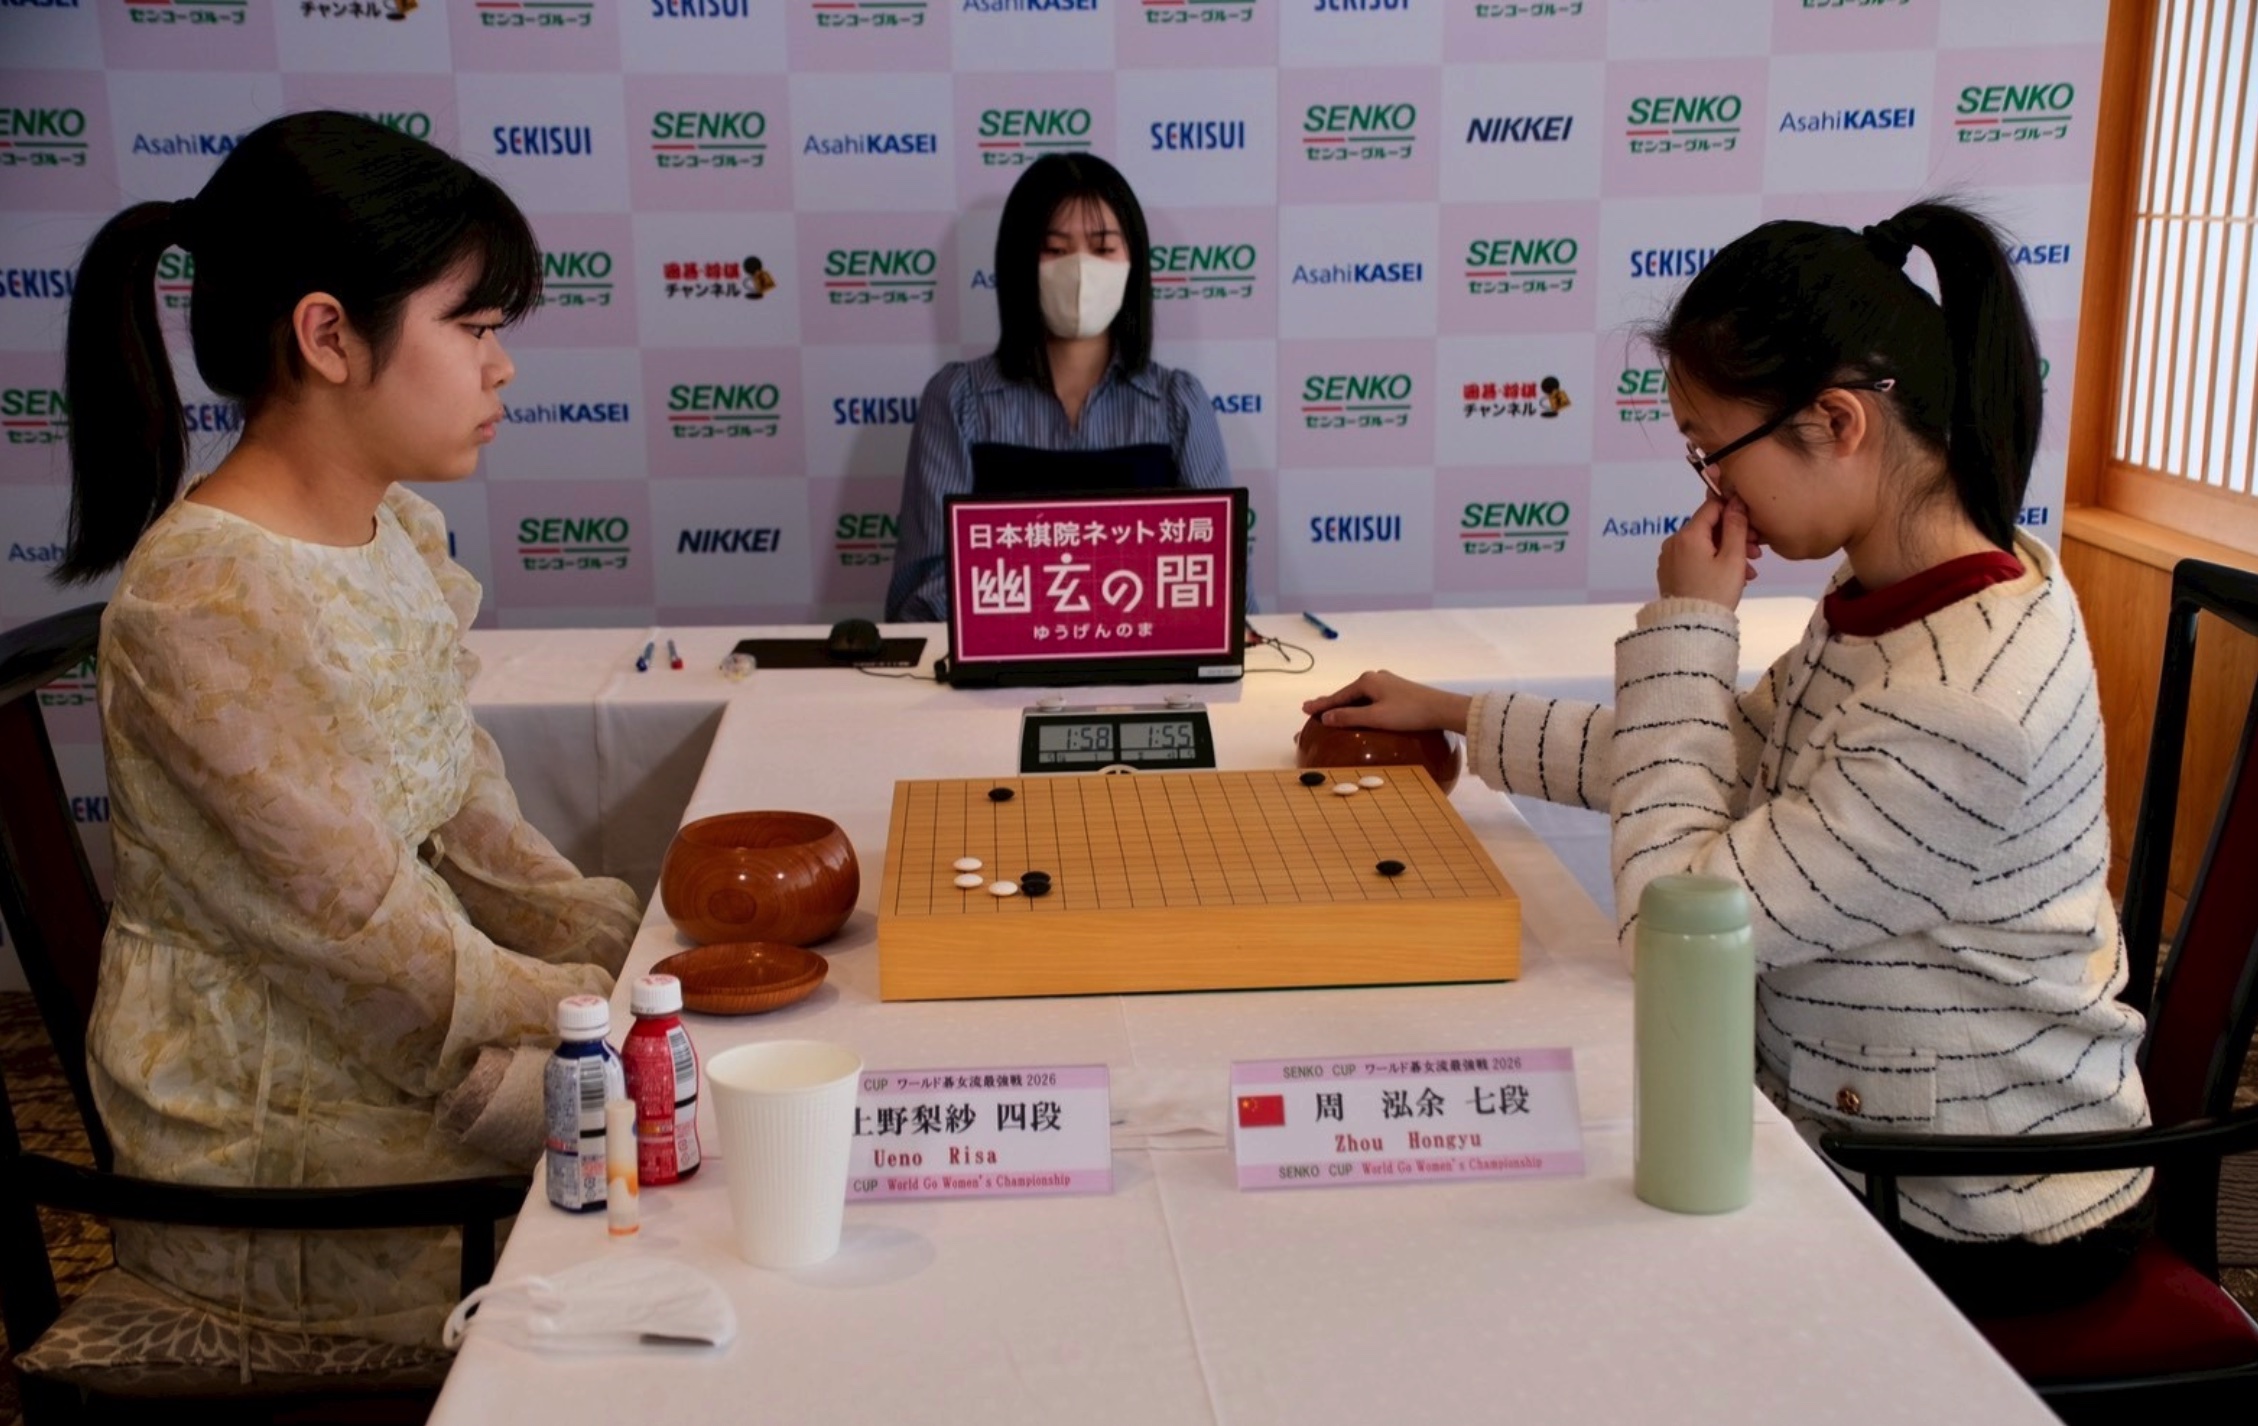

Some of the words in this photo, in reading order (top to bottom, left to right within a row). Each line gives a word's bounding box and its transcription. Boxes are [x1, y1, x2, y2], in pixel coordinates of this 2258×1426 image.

[1627, 95, 1741, 124] SENKO
[1956, 83, 2074, 114] SENKO
[0, 108, 85, 137] ENKO
[651, 111, 765, 139] SENKO
[978, 109, 1091, 137] SENKO
[1303, 104, 1416, 132] SENKO
[1466, 116, 1573, 143] NIKKEI
[1779, 109, 1915, 132] AsahiKASEI
[133, 133, 243, 155] AsahiKA
[493, 126, 592, 156] SEKISUI
[803, 134, 937, 155] AsahiKASEI
[1151, 121, 1245, 150] SEKISUI
[544, 252, 612, 278] NKO
[825, 249, 937, 276] SENKO
[1149, 245, 1256, 272] SENKO
[1466, 238, 1577, 266] SENKO
[1630, 249, 1714, 277] SEKISU
[1292, 263, 1423, 284] AsahiKASEI
[668, 384, 779, 411] SENKO
[1302, 374, 1411, 401] SENKO
[2, 389, 72, 416] SEN
[833, 397, 918, 425] SEKISU
[836, 514, 900, 539] SEN
[1461, 501, 1569, 529] SENKO
[1602, 516, 1691, 537] AsahiK
[518, 517, 629, 544] SENKO
[677, 529, 780, 553] NIKKEI
[969, 517, 1214, 549] 日本棋院ネット対局
[1311, 515, 1401, 543] SEKISUI
[971, 552, 1214, 615] 幽玄の間
[1033, 622, 1154, 641] ゆうげんのま
[1067, 727, 1109, 751] 1:58
[1149, 725, 1190, 749] 1:55
[1283, 1066, 1323, 1078] SENKO
[1332, 1064, 1356, 1076] CUP
[1493, 1057, 1522, 1071] 2026
[864, 1078, 888, 1091] CUP
[1027, 1073, 1056, 1086] 2026
[1465, 1085, 1529, 1115] 七段
[852, 1103, 977, 1136] 上野梨紗
[997, 1101, 1061, 1132] 四段
[1335, 1134, 1383, 1153] Zhou
[1408, 1131, 1481, 1150] Hongyu
[874, 1149, 922, 1168] Ueno
[949, 1145, 997, 1165] Risa
[1279, 1165, 1319, 1179] SENKO
[1328, 1163, 1352, 1176] CUP
[1362, 1161, 1393, 1174] World
[1397, 1160, 1412, 1174] Go
[1469, 1156, 1542, 1170] Championship
[853, 1179, 878, 1192] CUP
[887, 1178, 919, 1191] World
[923, 1177, 938, 1190] Go
[996, 1174, 1071, 1188] Championship
